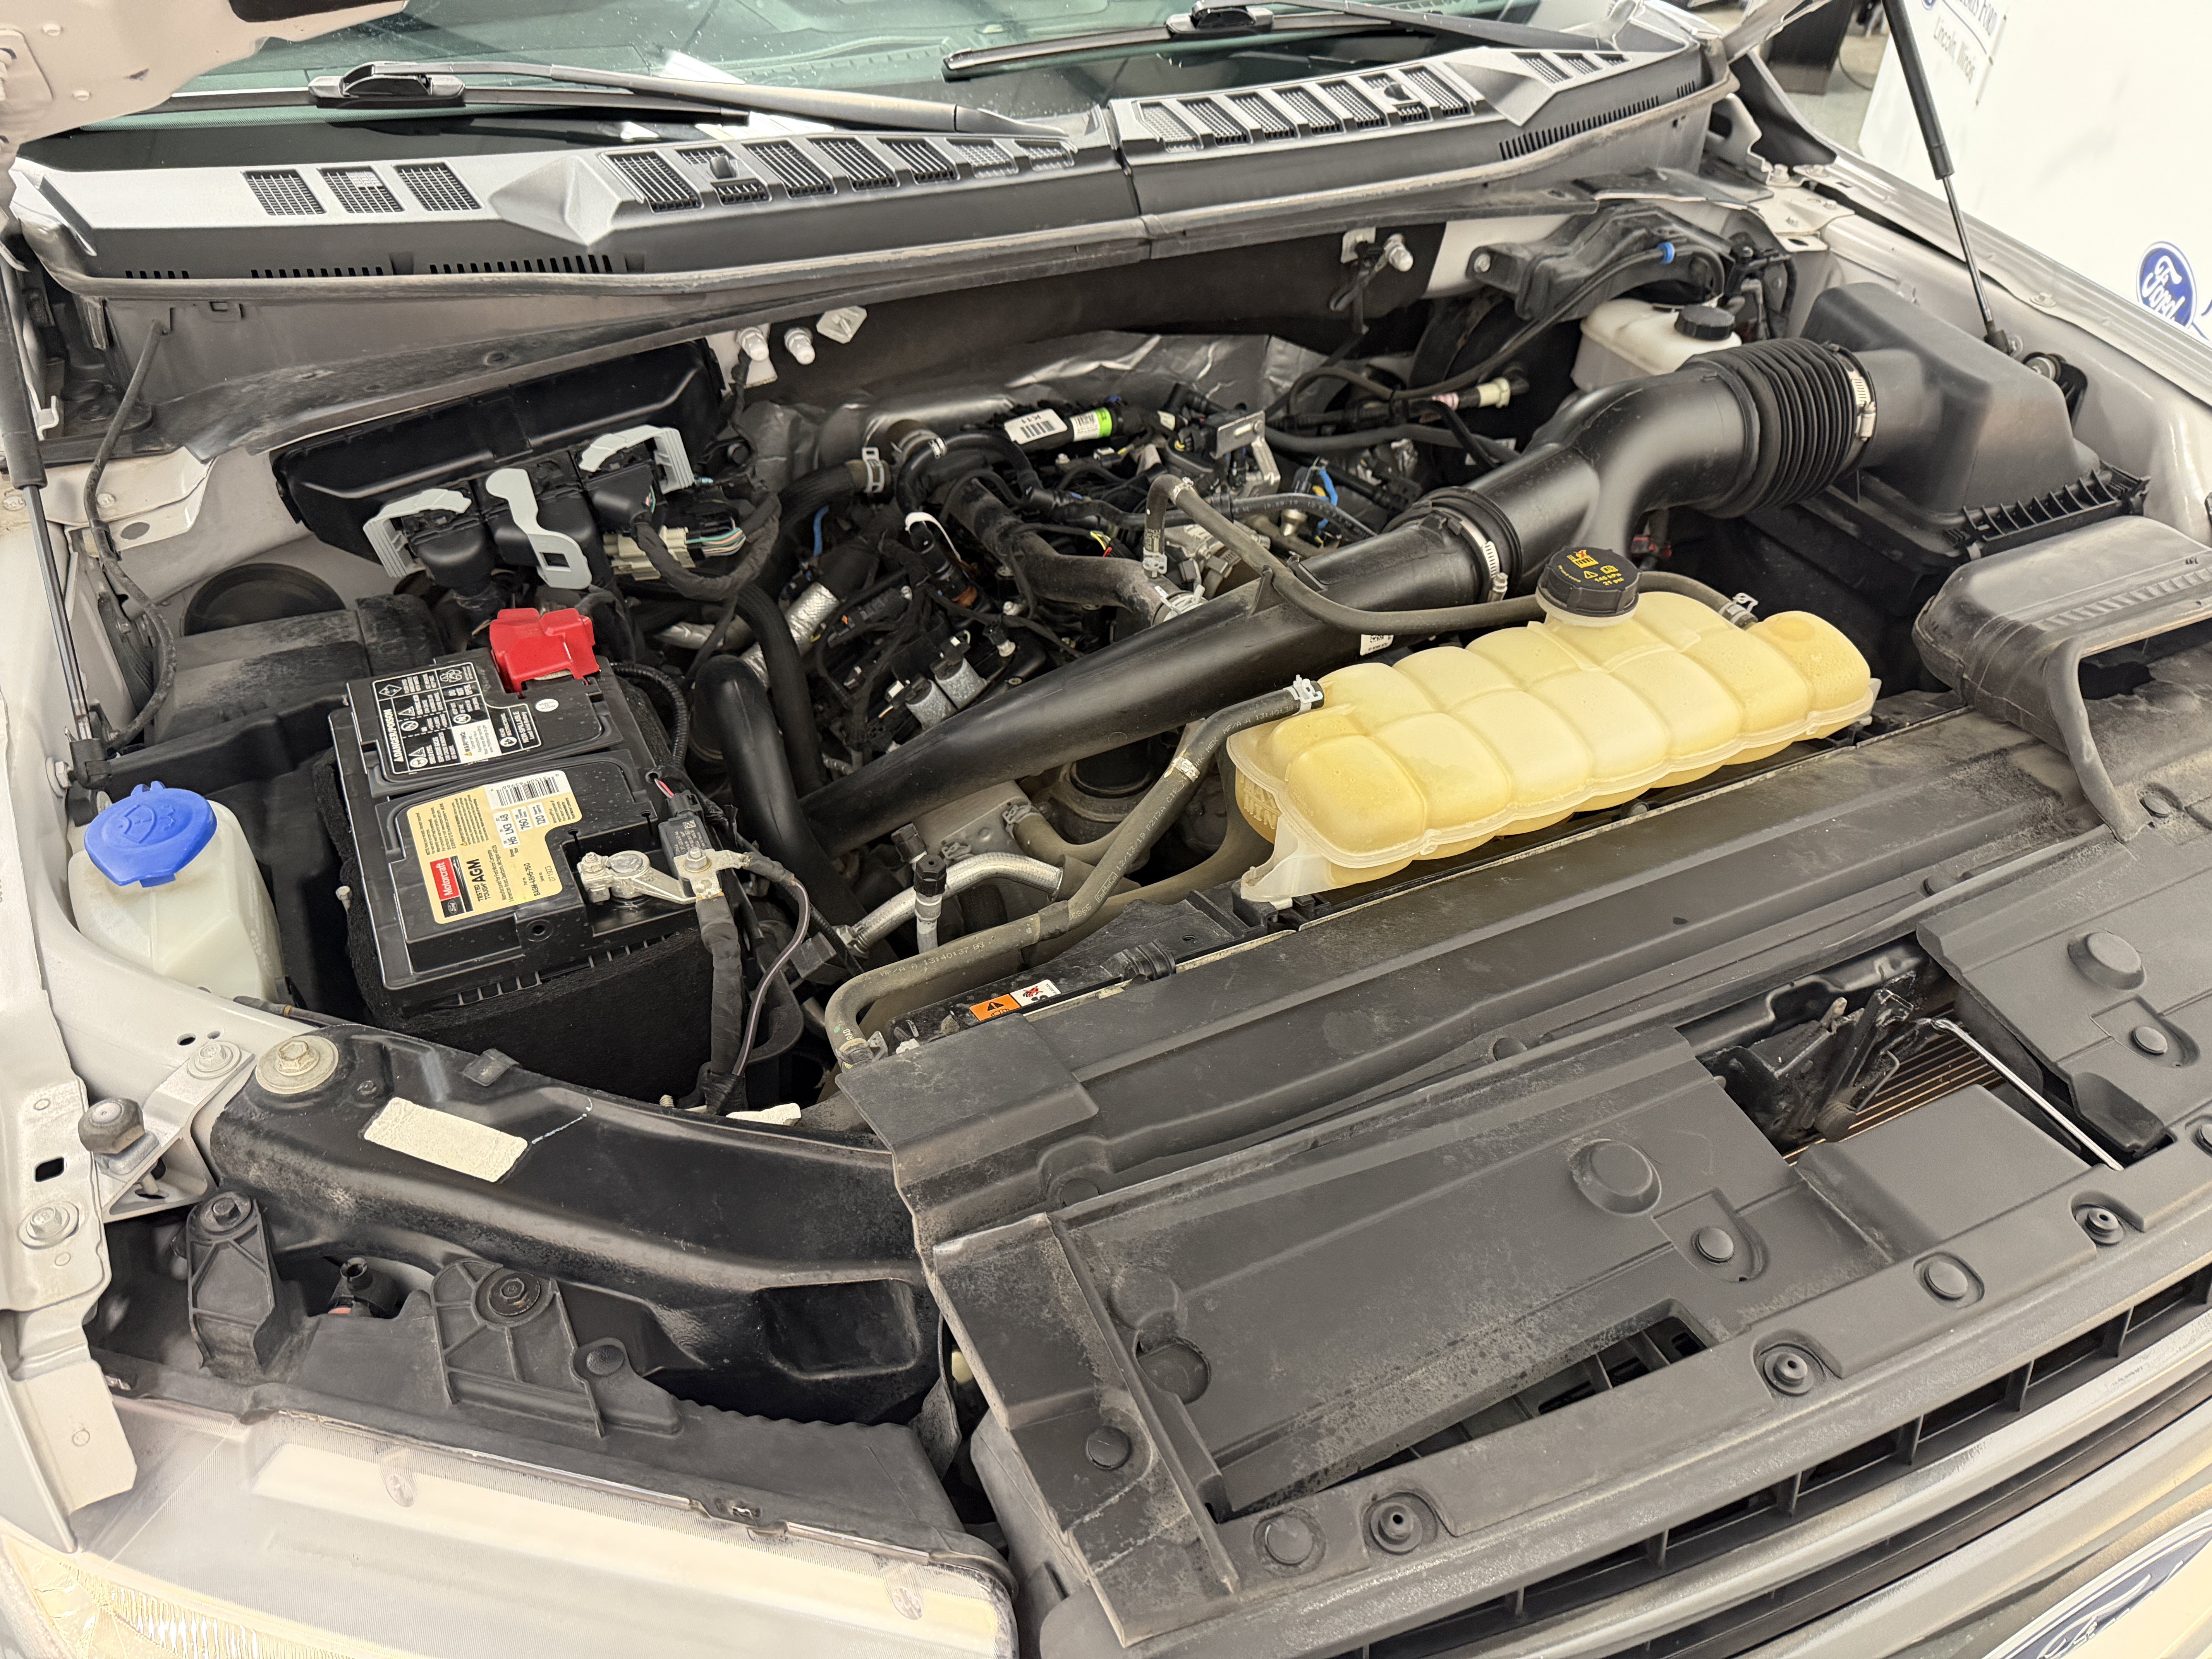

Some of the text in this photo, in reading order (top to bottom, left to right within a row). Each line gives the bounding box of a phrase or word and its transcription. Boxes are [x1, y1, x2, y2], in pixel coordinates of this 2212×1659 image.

[2142, 255, 2185, 320] Ford
[383, 709, 403, 757] DANGER/POISON
[513, 711, 529, 742] NON-SPILLABLE
[1115, 831, 1147, 871] 12/13/19
[1205, 736, 1219, 752] MEX
[1222, 720, 1242, 734] MF/A
[519, 818, 530, 830] 760
[536, 815, 546, 824] 120
[1244, 795, 1276, 829] MIN
[500, 814, 518, 845] H6 LN3 48
[436, 862, 453, 896] Motorcraft
[466, 859, 485, 882] AGM
[545, 866, 555, 881] 071923
[474, 884, 483, 901] TESTED
[923, 946, 970, 966] 13:40:37
[842, 1028, 854, 1040] RAD
